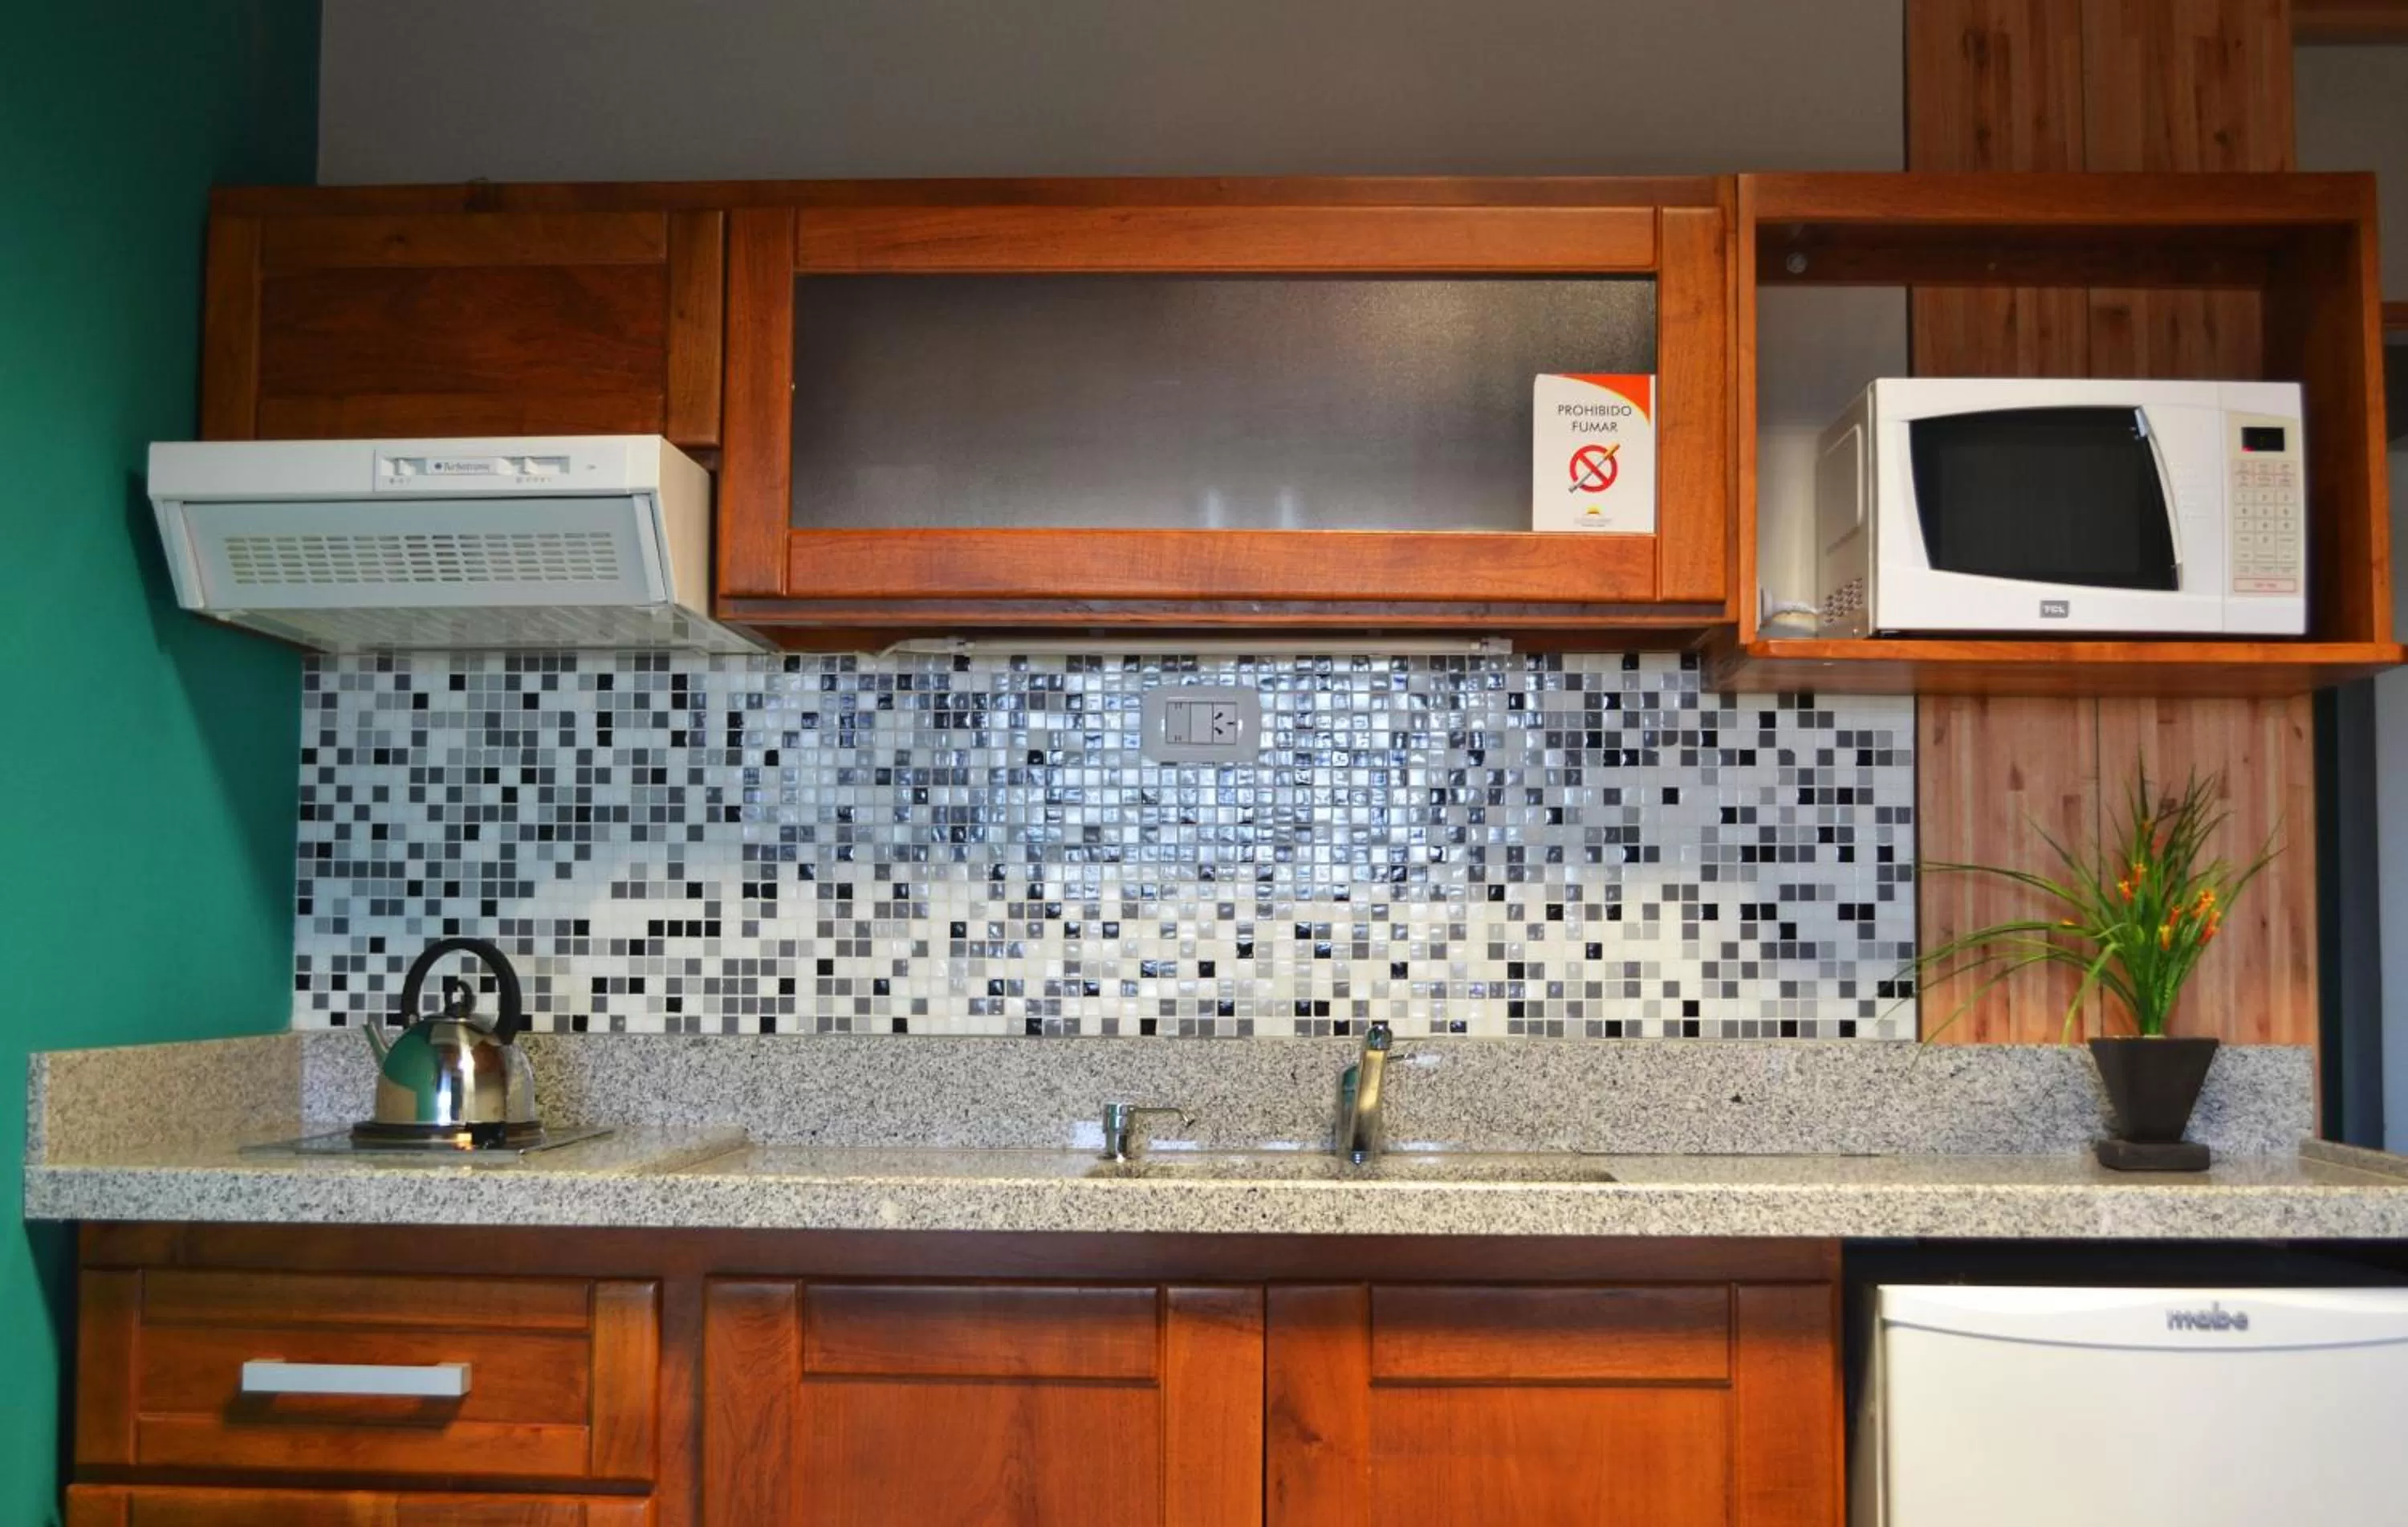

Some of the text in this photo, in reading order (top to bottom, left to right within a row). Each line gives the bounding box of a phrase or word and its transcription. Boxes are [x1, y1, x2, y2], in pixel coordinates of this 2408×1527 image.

[1557, 404, 1633, 417] PROHIBIDO
[1572, 421, 1618, 433] FUMAR
[2166, 1301, 2249, 1331] mabe
